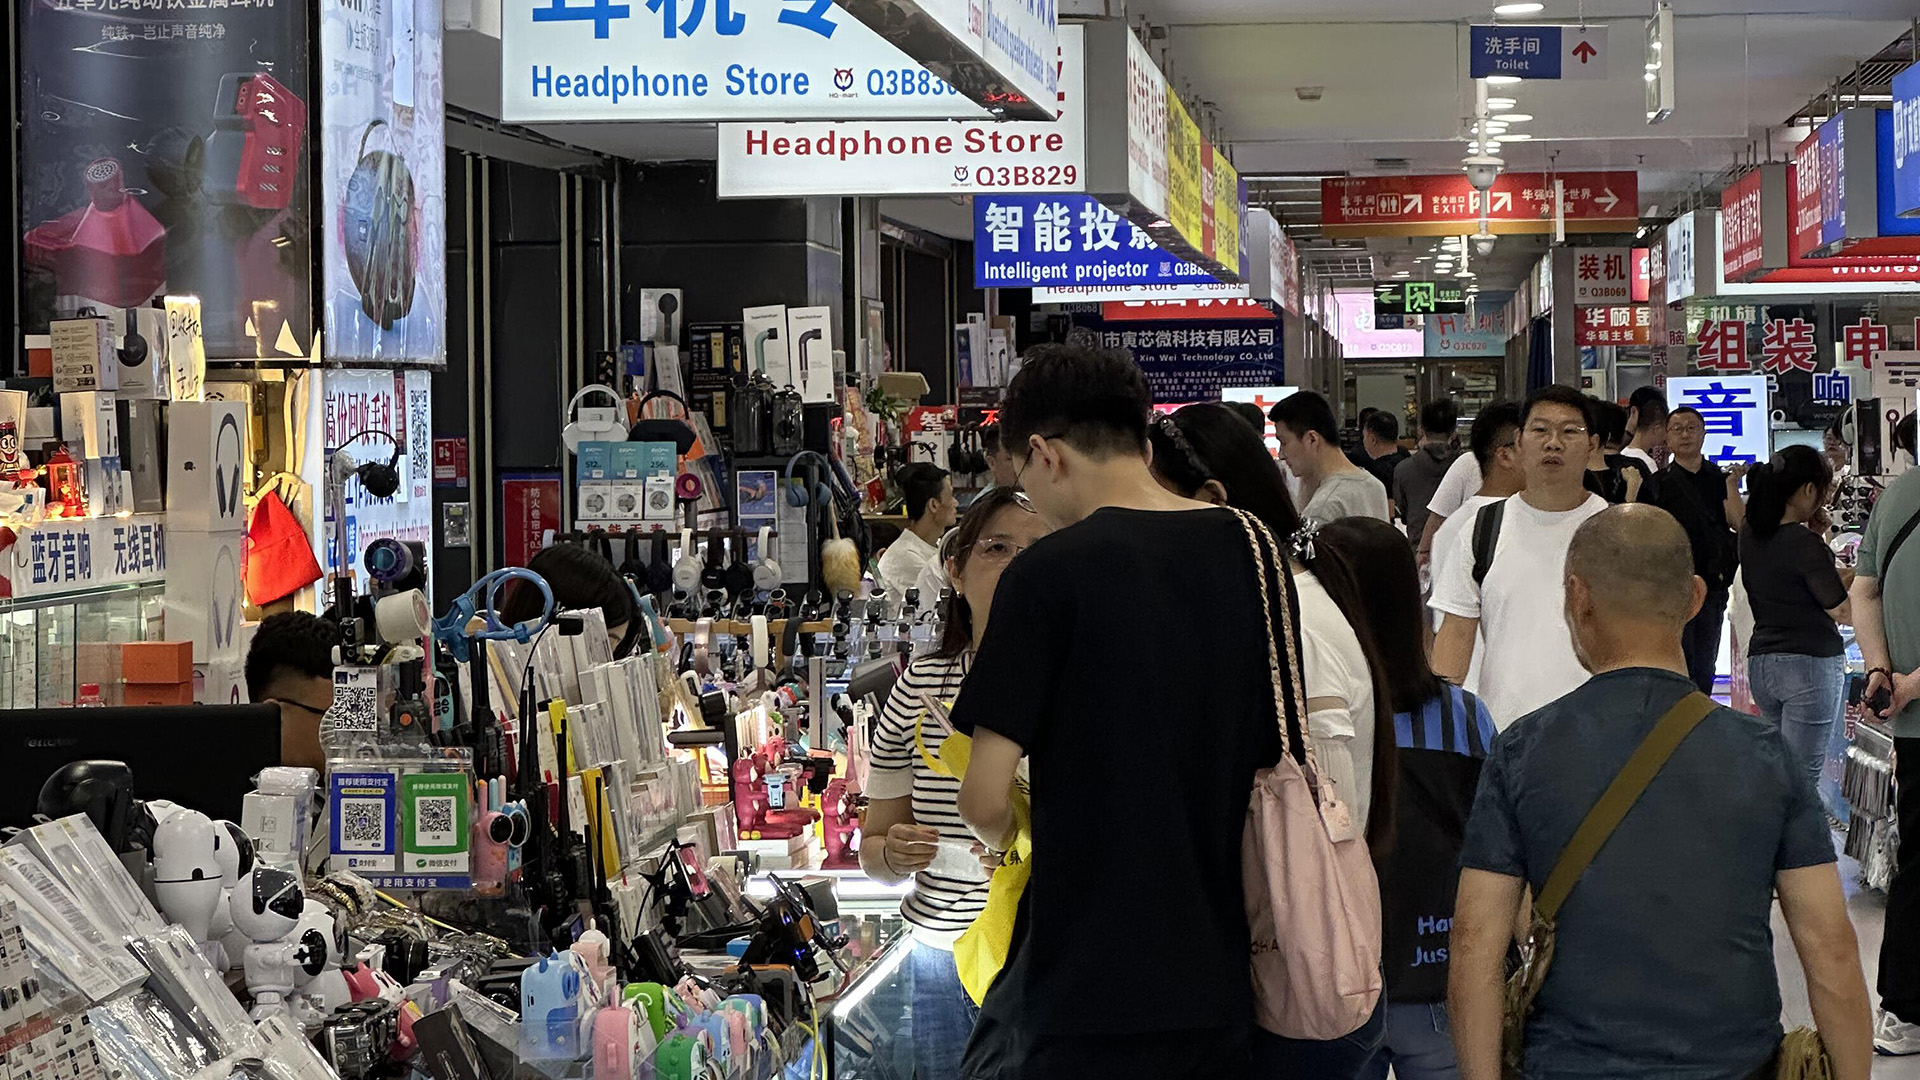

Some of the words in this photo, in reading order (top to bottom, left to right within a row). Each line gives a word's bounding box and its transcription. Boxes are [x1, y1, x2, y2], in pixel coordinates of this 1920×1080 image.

[1485, 37, 1541, 56] 洗手间
[1495, 59, 1530, 70] Toilet
[532, 65, 708, 104] Headphone
[725, 63, 810, 96] Store
[746, 129, 952, 161] Headphone
[964, 128, 1064, 154] Store
[976, 165, 1077, 187] Q3B829
[1432, 196, 1465, 204] 安全出口
[1522, 188, 1592, 200] 华强电世界
[1340, 208, 1375, 216] TOILET
[1433, 205, 1465, 214] EXIT
[985, 262, 1067, 282] Intelligent
[1075, 262, 1149, 281] projector
[1579, 254, 1626, 281] 装机
[1591, 287, 1627, 297] Q3B069
[1697, 317, 1920, 375] 组装电
[1139, 354, 1155, 362] Xin
[1160, 353, 1177, 361] Wei
[1182, 353, 1235, 363] Technology
[325, 390, 393, 447] 高价回收手机
[31, 527, 92, 584] 蓝牙音响
[113, 522, 166, 575] 无线耳机
[358, 859, 377, 867] 支付宝
[428, 859, 457, 867] 微信支付
[1410, 946, 1448, 967] Jus
